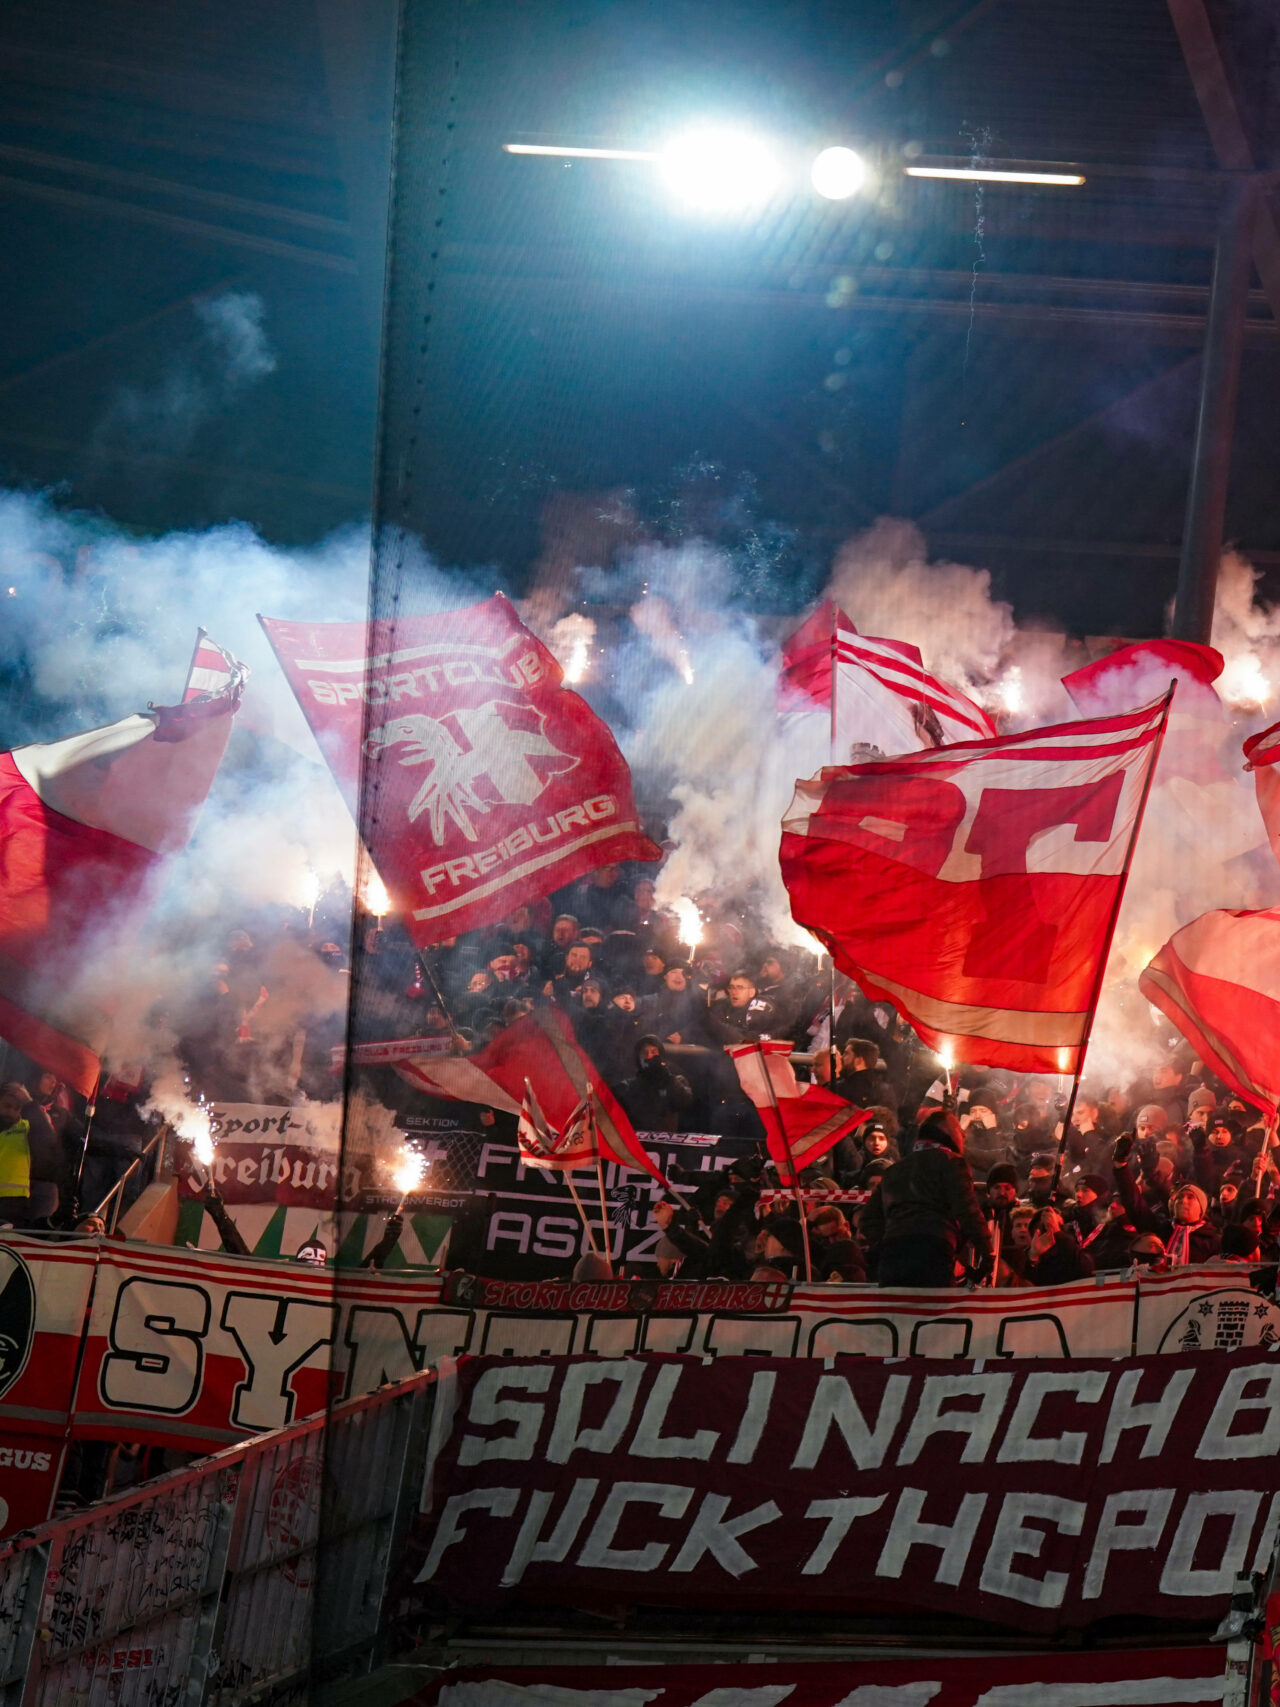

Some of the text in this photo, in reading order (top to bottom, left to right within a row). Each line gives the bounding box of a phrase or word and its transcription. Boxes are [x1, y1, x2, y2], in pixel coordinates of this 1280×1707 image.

[420, 795, 616, 896] FREIBURG
[406, 1116, 459, 1129] SEKTION
[485, 1282, 765, 1312] SPORT CLUB FREIBURG
[456, 1359, 777, 1468] SOLI
[791, 1366, 1199, 1471] NACH
[413, 1479, 783, 1588] FUCK
